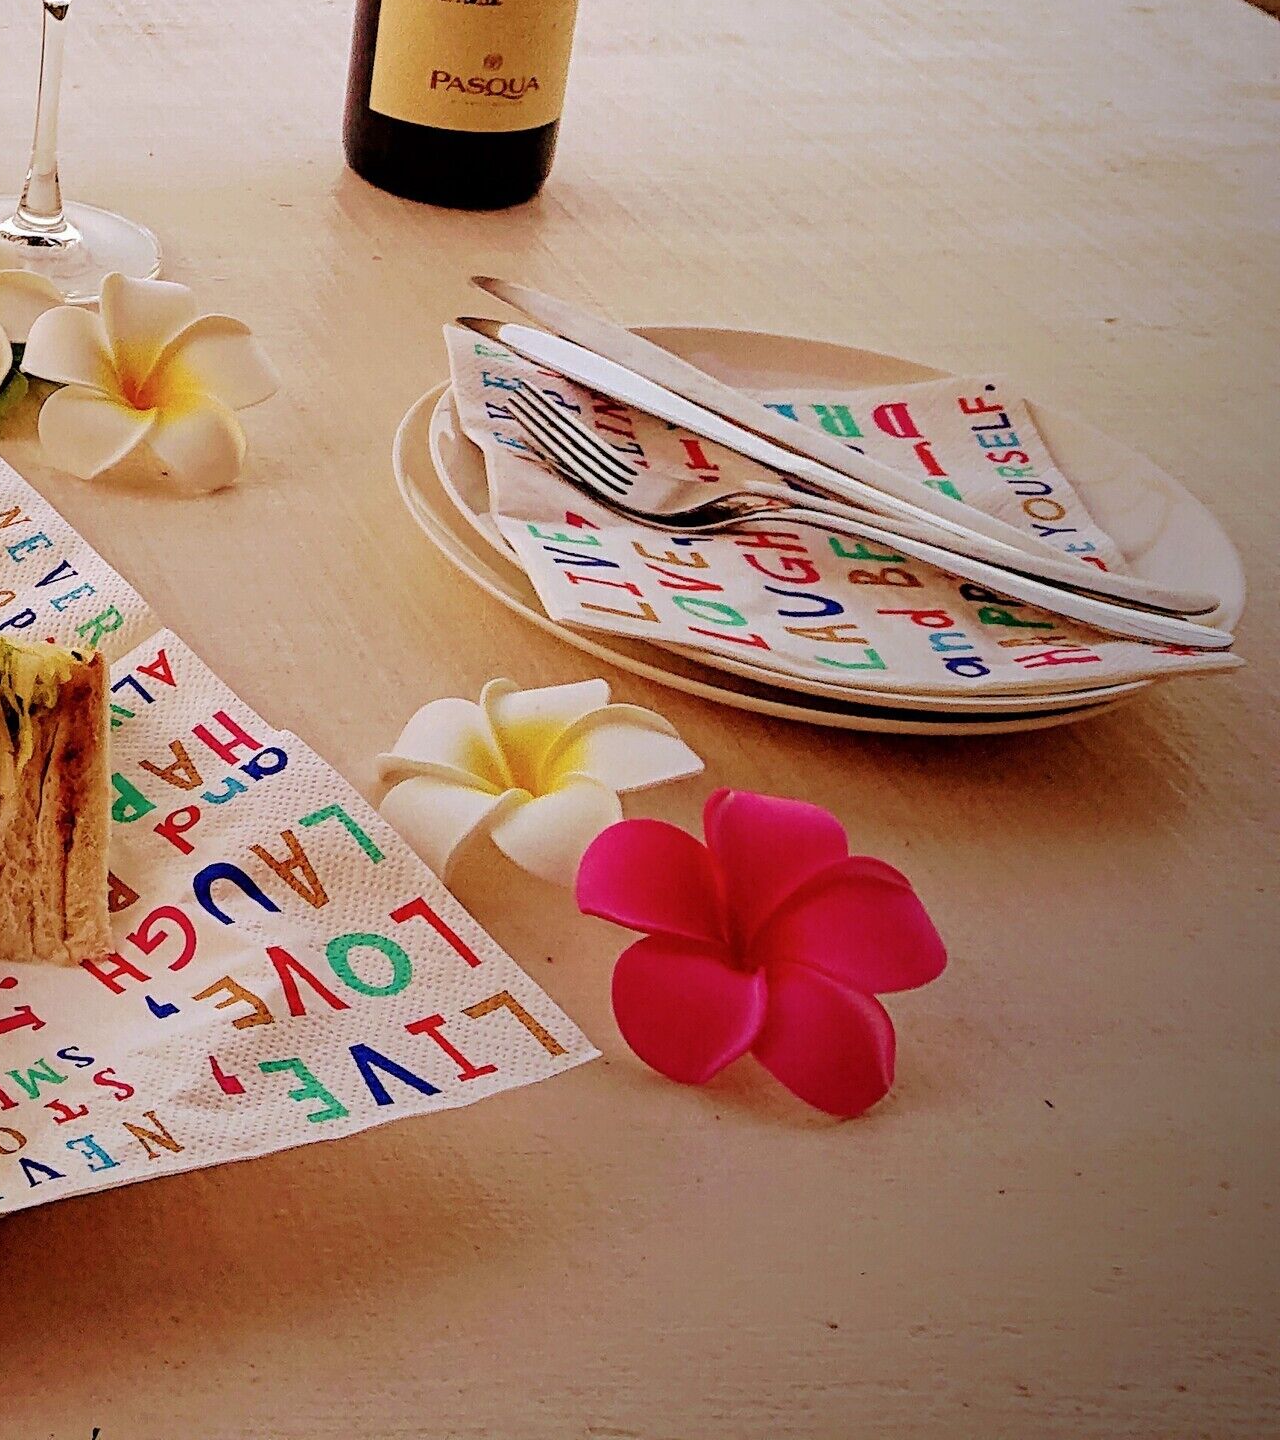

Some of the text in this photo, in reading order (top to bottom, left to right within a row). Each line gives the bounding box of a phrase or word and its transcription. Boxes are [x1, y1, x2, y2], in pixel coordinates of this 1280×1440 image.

[429, 69, 540, 100] PASQUA
[957, 383, 1078, 538] YOURSELF.
[526, 510, 661, 623] LIVE,
[632, 536, 772, 651] LOVE,
[735, 530, 887, 670] LAUGH
[876, 609, 991, 678] and
[153, 746, 289, 856] and
[81, 803, 387, 995] LAUGH
[144, 896, 483, 1030] LOVE,
[208, 989, 569, 1124] LIVE,
